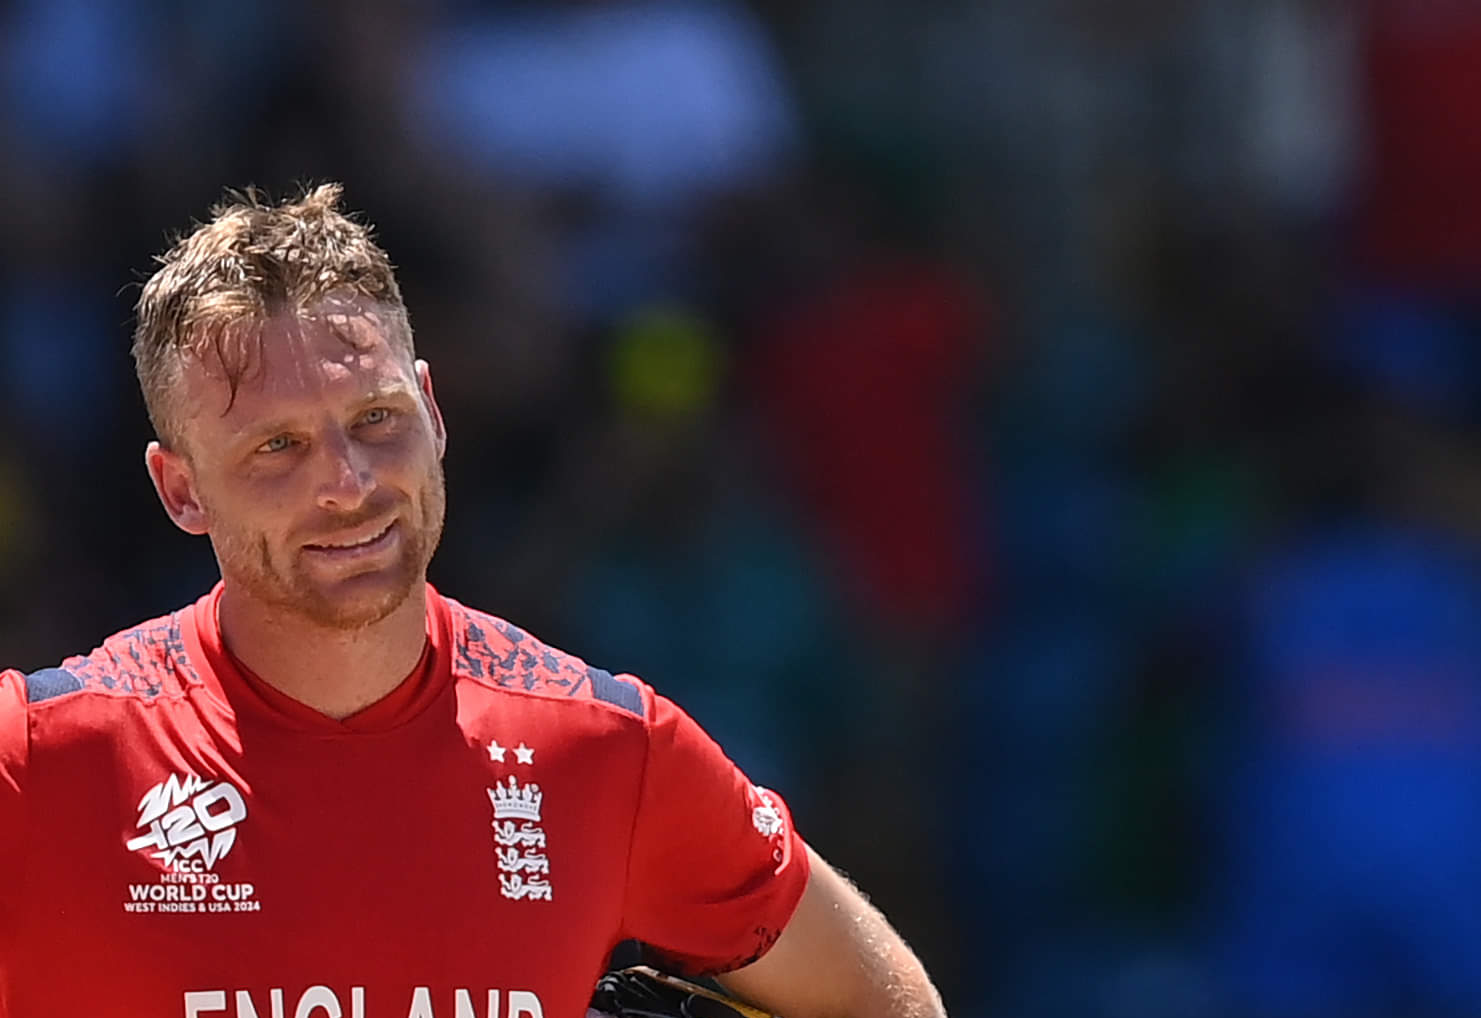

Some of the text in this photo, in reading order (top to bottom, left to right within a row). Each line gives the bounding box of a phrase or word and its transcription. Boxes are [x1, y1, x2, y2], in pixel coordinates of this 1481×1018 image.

[173, 859, 204, 873] ICC
[198, 873, 220, 884] T20
[128, 883, 254, 901] WORLD CUP
[124, 901, 261, 912] WEST INDIES & USA 2024
